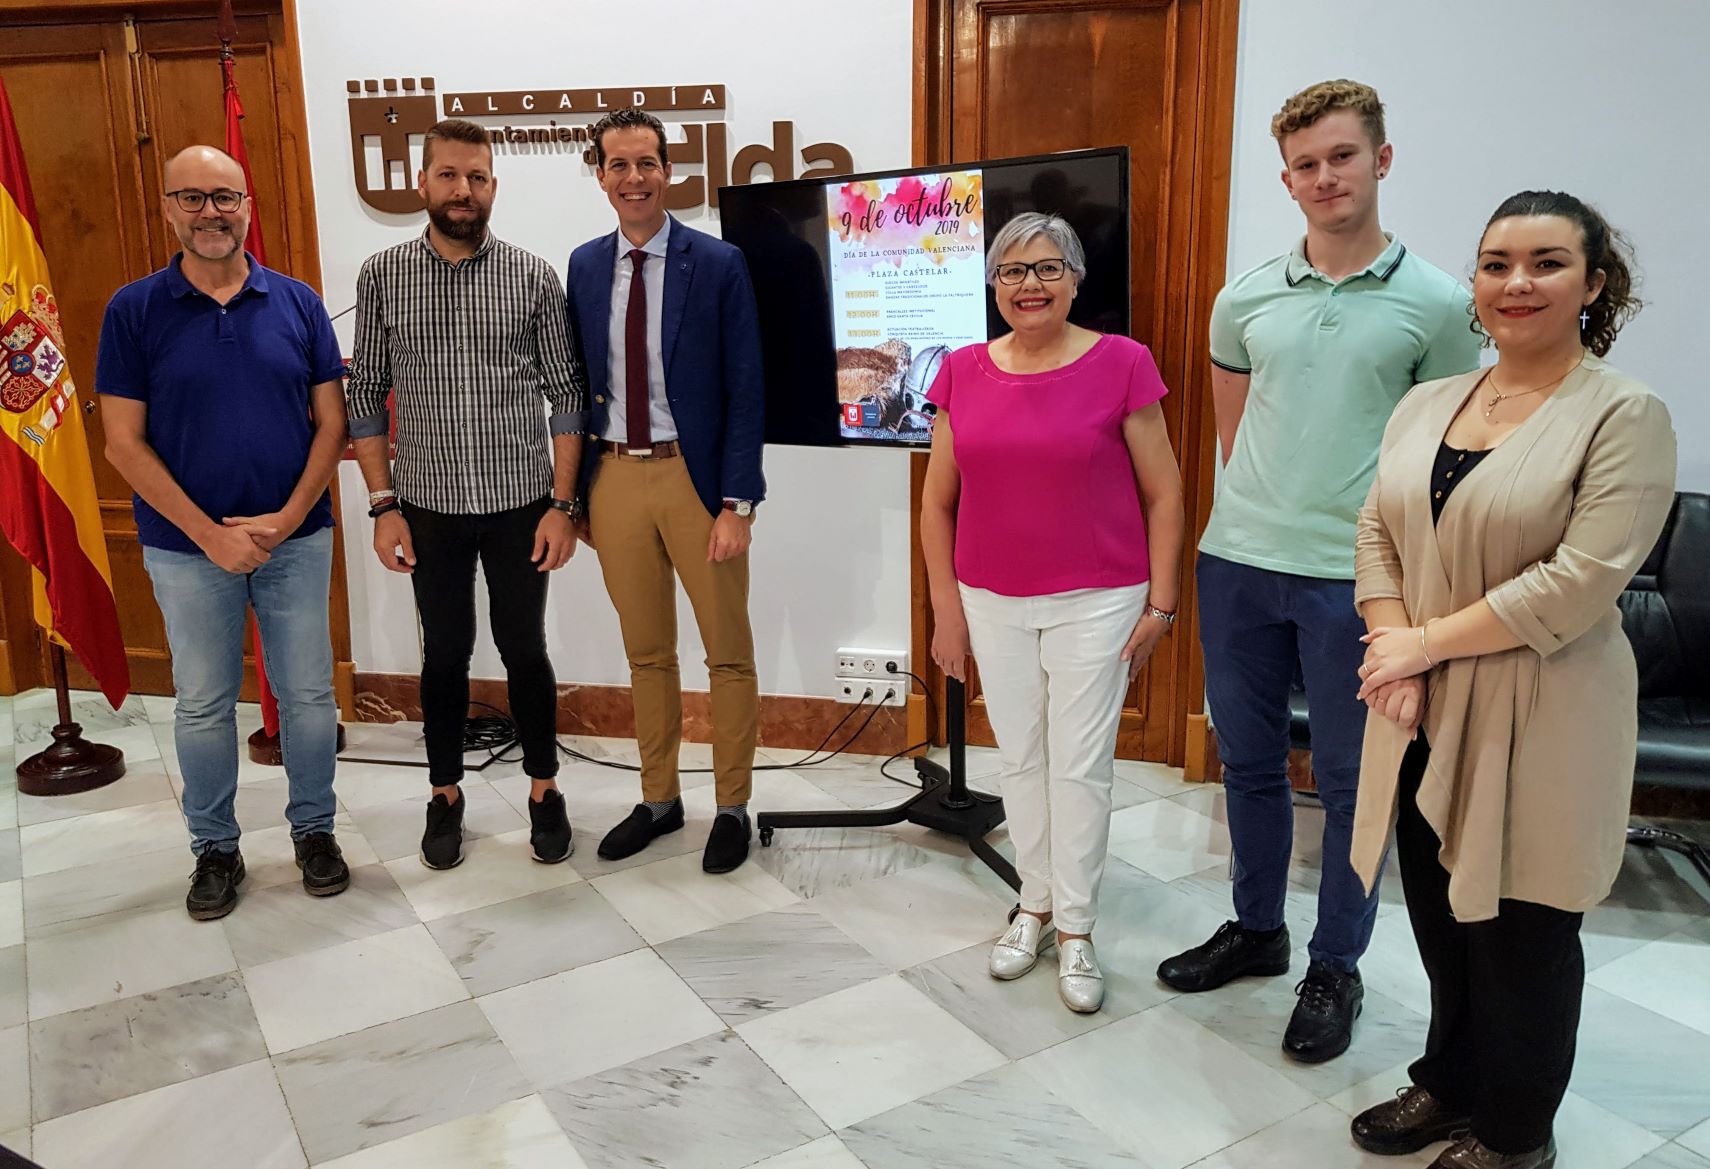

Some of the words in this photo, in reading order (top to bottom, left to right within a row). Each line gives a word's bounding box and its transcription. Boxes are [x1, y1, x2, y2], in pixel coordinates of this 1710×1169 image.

[451, 86, 716, 112] ALCALDÍA
[491, 120, 595, 144] ntamient
[842, 211, 851, 235] 9
[860, 199, 887, 232] de
[894, 177, 978, 226] octubre
[935, 220, 960, 235] 2019
[883, 248, 924, 256] COMUNIDAD
[928, 245, 976, 254] VALENCIANA
